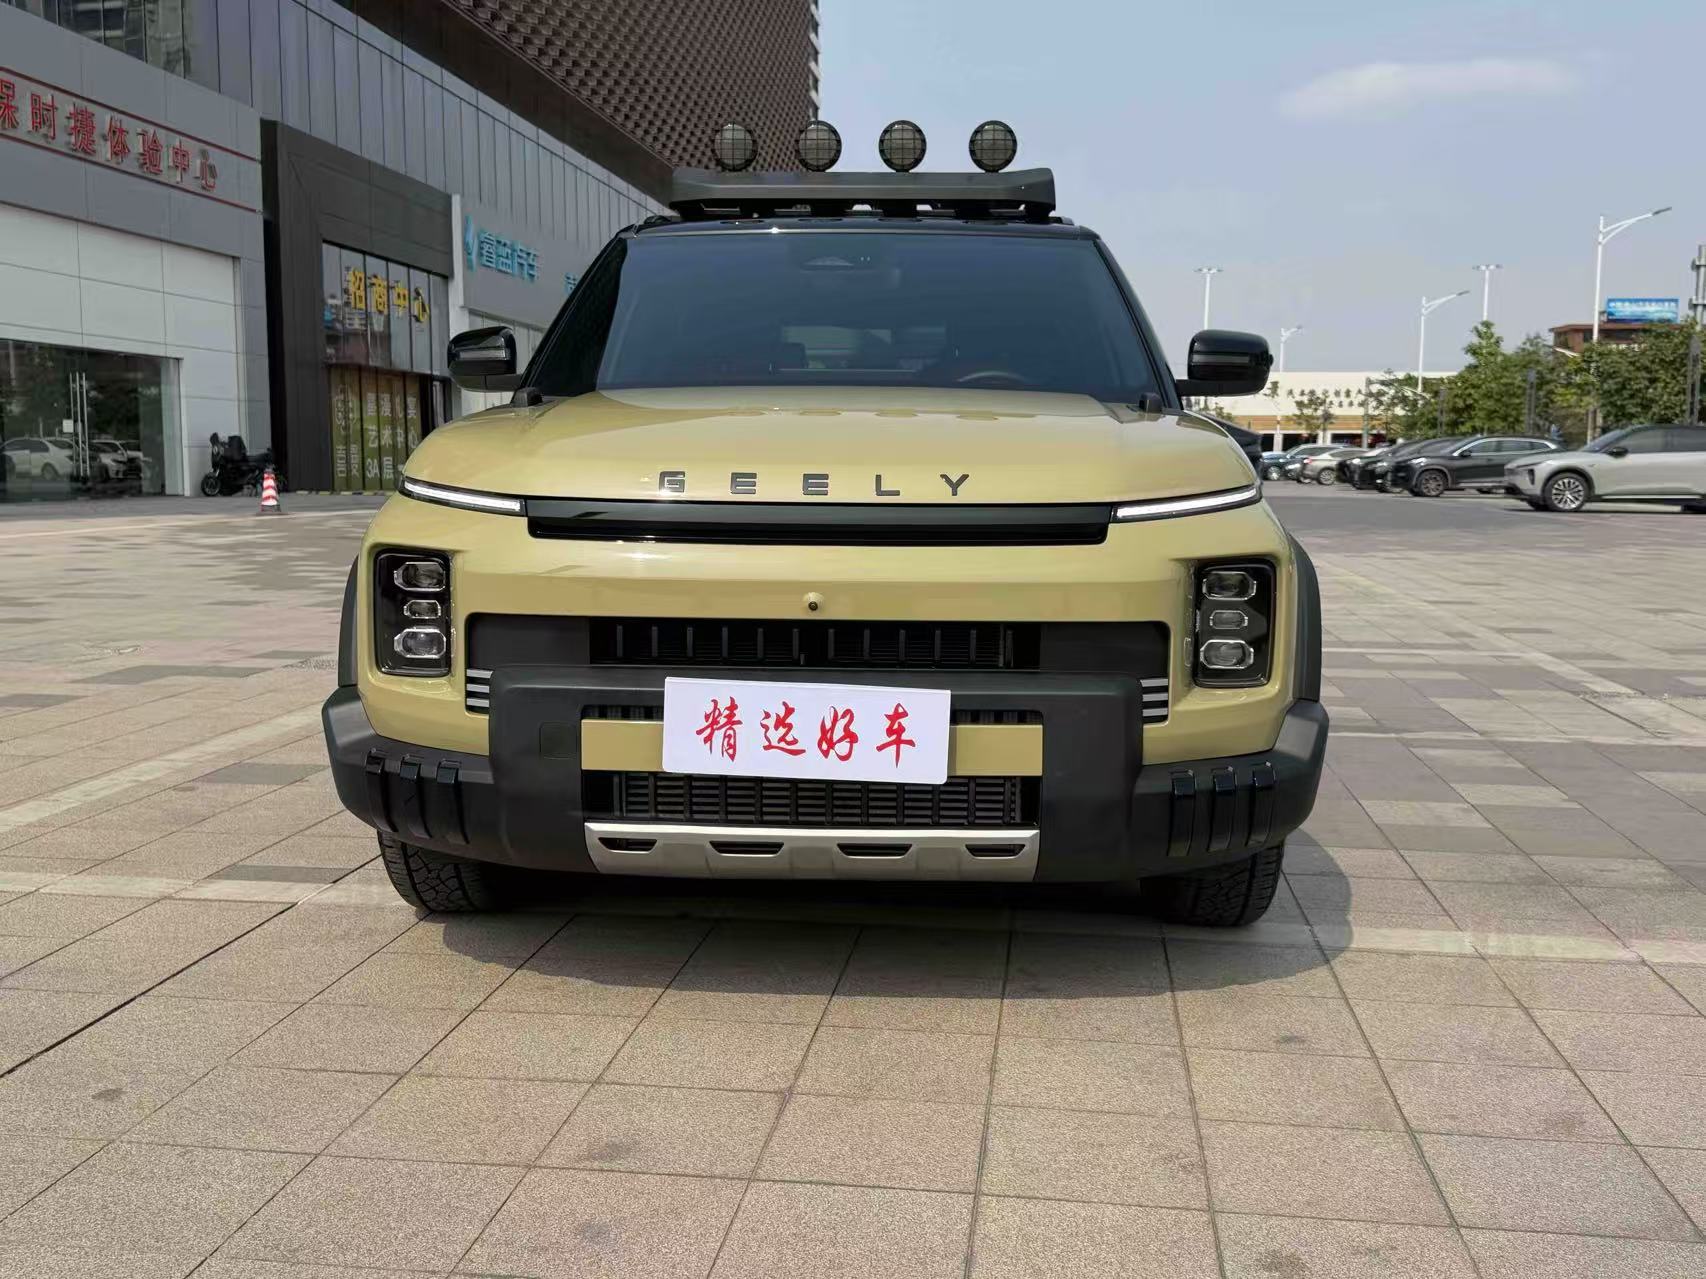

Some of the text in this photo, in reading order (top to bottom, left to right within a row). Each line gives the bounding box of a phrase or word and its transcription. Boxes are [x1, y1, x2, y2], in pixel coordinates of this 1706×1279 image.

[346, 267, 431, 324] 招商中心
[659, 470, 970, 497] GEELY
[695, 696, 916, 769] 精选好车
